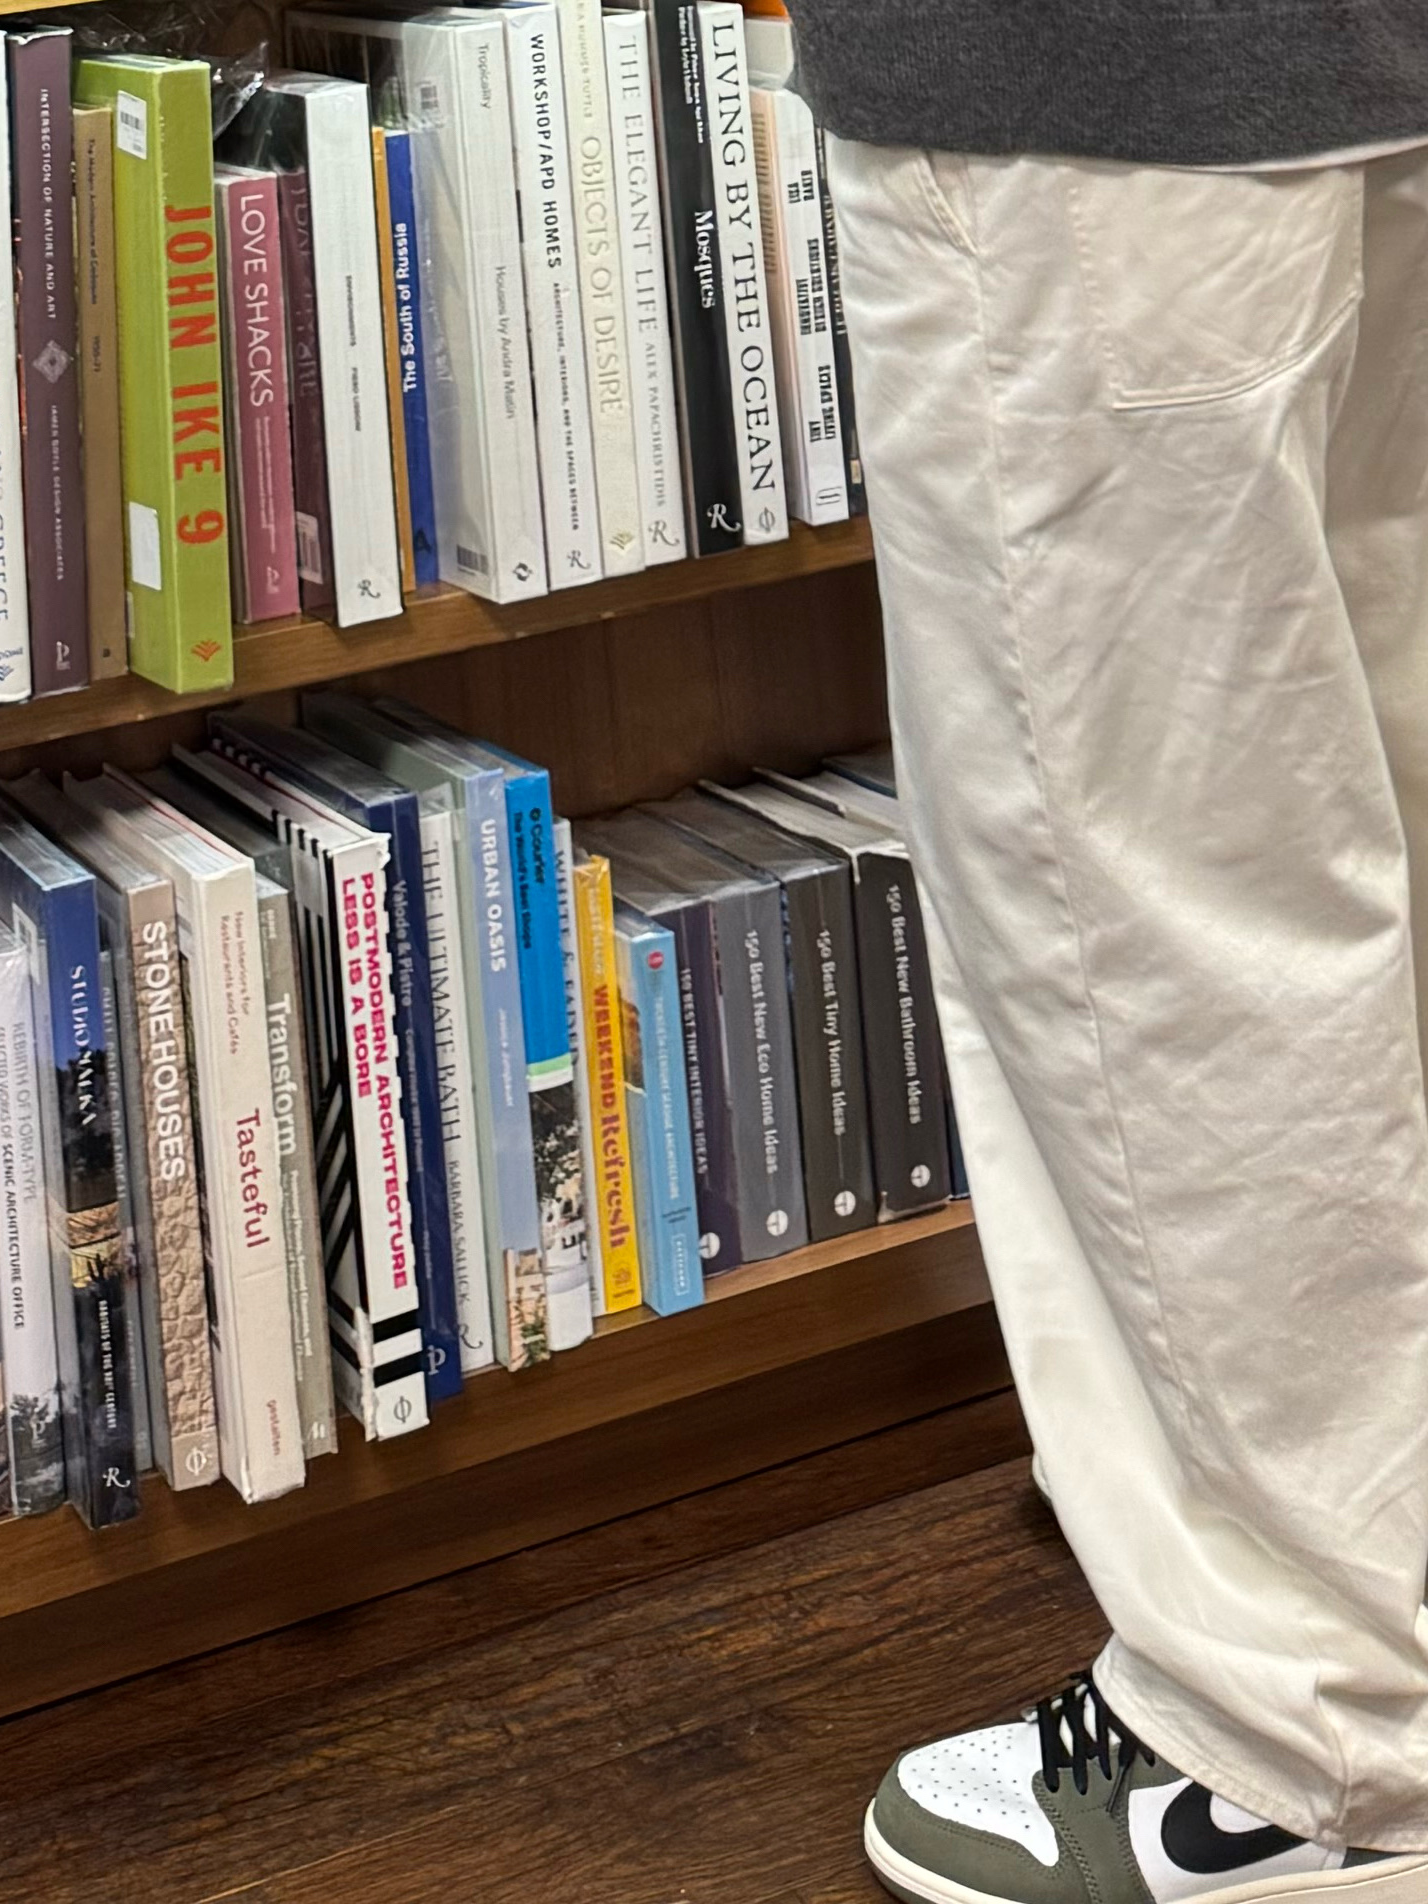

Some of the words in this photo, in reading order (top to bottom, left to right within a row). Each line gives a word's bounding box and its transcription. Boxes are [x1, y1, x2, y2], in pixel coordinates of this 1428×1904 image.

[711, 21, 747, 169] LIVING
[239, 194, 266, 273] LOVE
[726, 177, 752, 231] BY
[165, 204, 213, 350] JOHN
[693, 208, 717, 310] Mosques
[732, 243, 761, 334] THE
[245, 283, 274, 407] SHACKS
[172, 383, 222, 480] IKE
[739, 344, 776, 492] OCEAN
[176, 508, 224, 544] 9
[480, 818, 504, 905] URBAN
[341, 877, 360, 955] LESS
[486, 910, 509, 973] OASIS
[890, 915, 907, 954] Best
[142, 919, 172, 1037] STONE
[348, 958, 363, 983] IS
[352, 994, 366, 1016] A
[895, 955, 912, 995] New
[353, 1021, 372, 1098] BORE
[898, 996, 918, 1078] Bathroom
[151, 1038, 186, 1182] HOUSES
[360, 871, 390, 1064] POSTMODERN
[375, 1073, 409, 1291] ARCHITECTURE
[906, 1079, 922, 1124] Ideas
[235, 1107, 271, 1249] Tasteful
